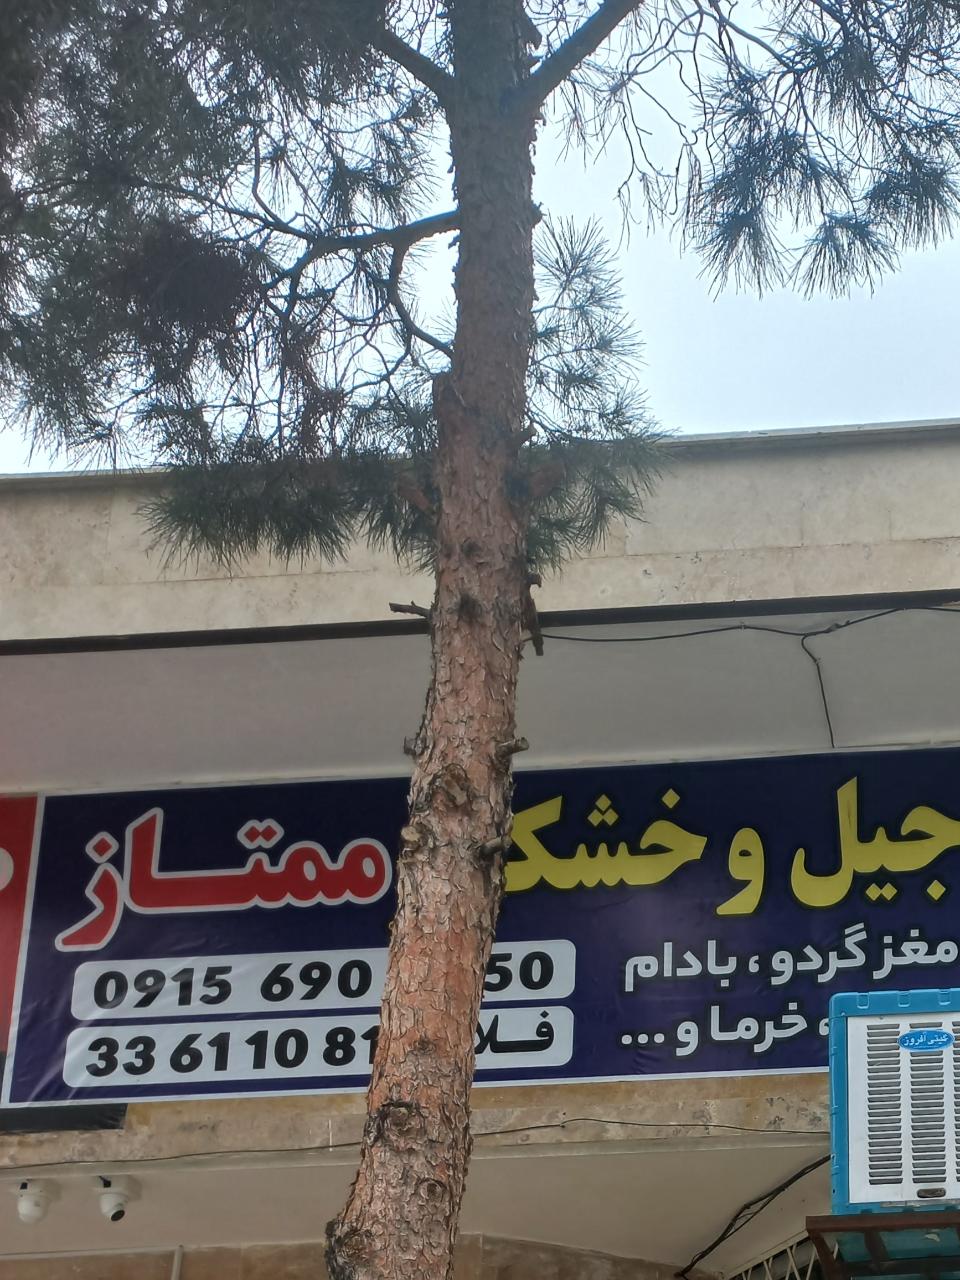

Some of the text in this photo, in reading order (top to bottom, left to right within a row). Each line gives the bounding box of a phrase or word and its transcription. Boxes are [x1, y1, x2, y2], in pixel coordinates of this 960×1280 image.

[504, 787, 708, 892] خشک
[54, 807, 393, 953] ممتاز
[715, 826, 765, 916] و
[92, 950, 555, 1010] 0915 690 50
[624, 938, 737, 993] بادام
[873, 931, 959, 979] مغز
[474, 1010, 555, 1055] فلا
[675, 1020, 700, 1057] و
[710, 1002, 808, 1053] خرما
